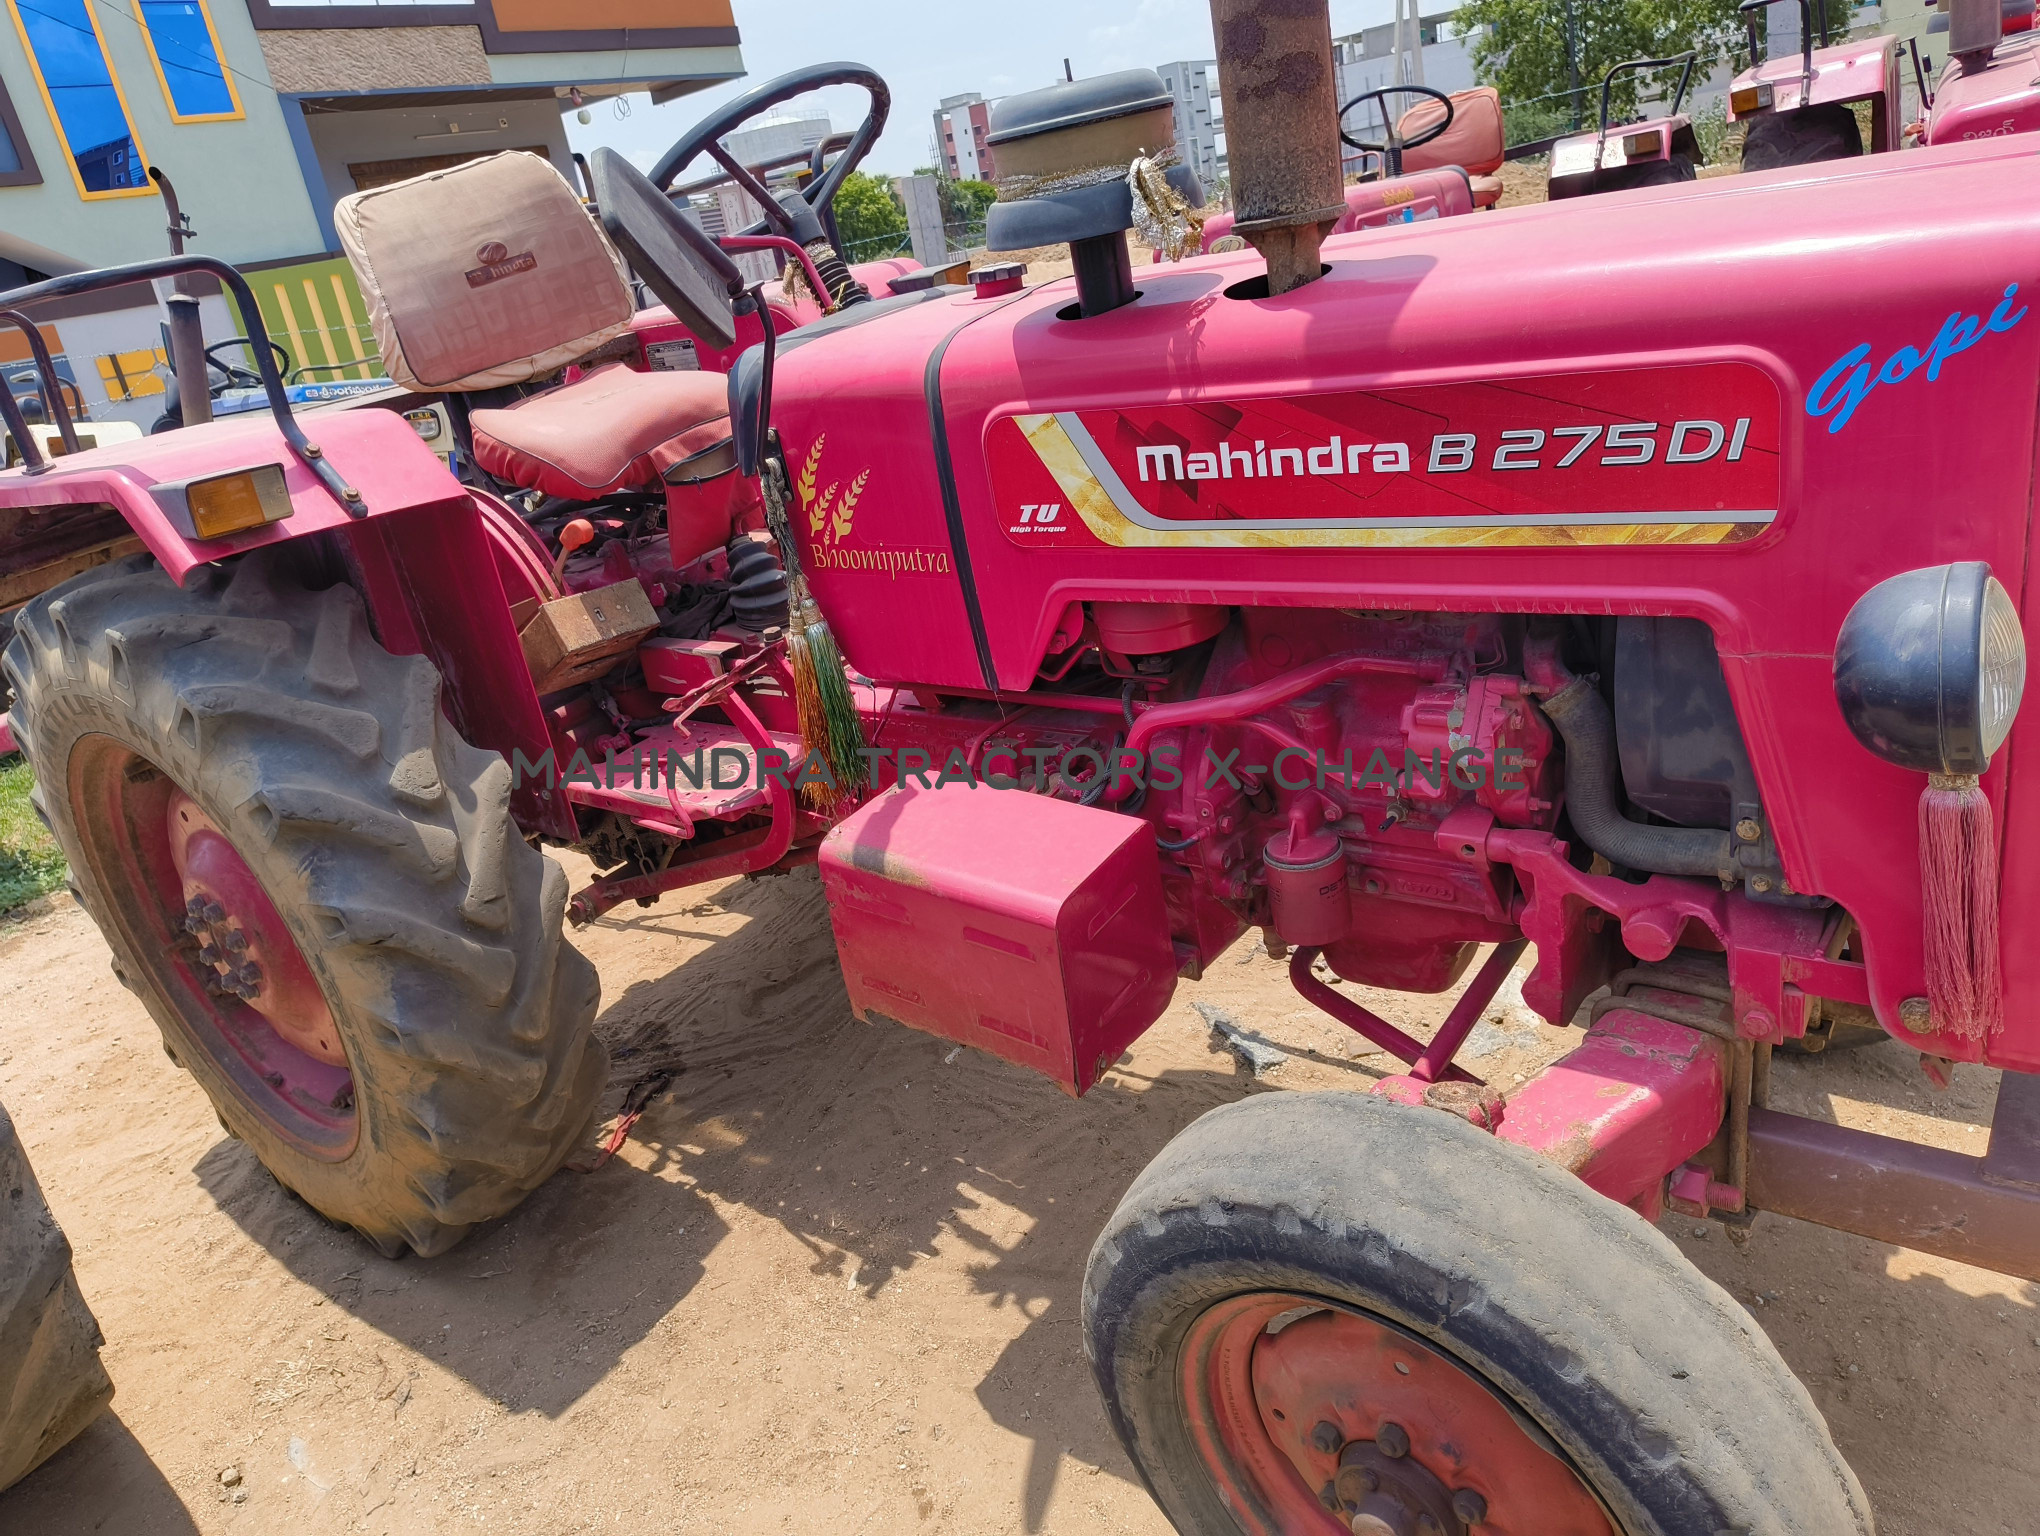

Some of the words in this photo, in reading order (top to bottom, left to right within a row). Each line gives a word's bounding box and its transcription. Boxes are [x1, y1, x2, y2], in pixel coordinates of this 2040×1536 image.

[1806, 283, 2027, 433] Gopi
[1427, 433, 1476, 473] B
[1009, 526, 1032, 534] High
[1034, 525, 1067, 534] Torque
[1019, 503, 1061, 523] TU
[810, 544, 950, 580] Bhoomiputra
